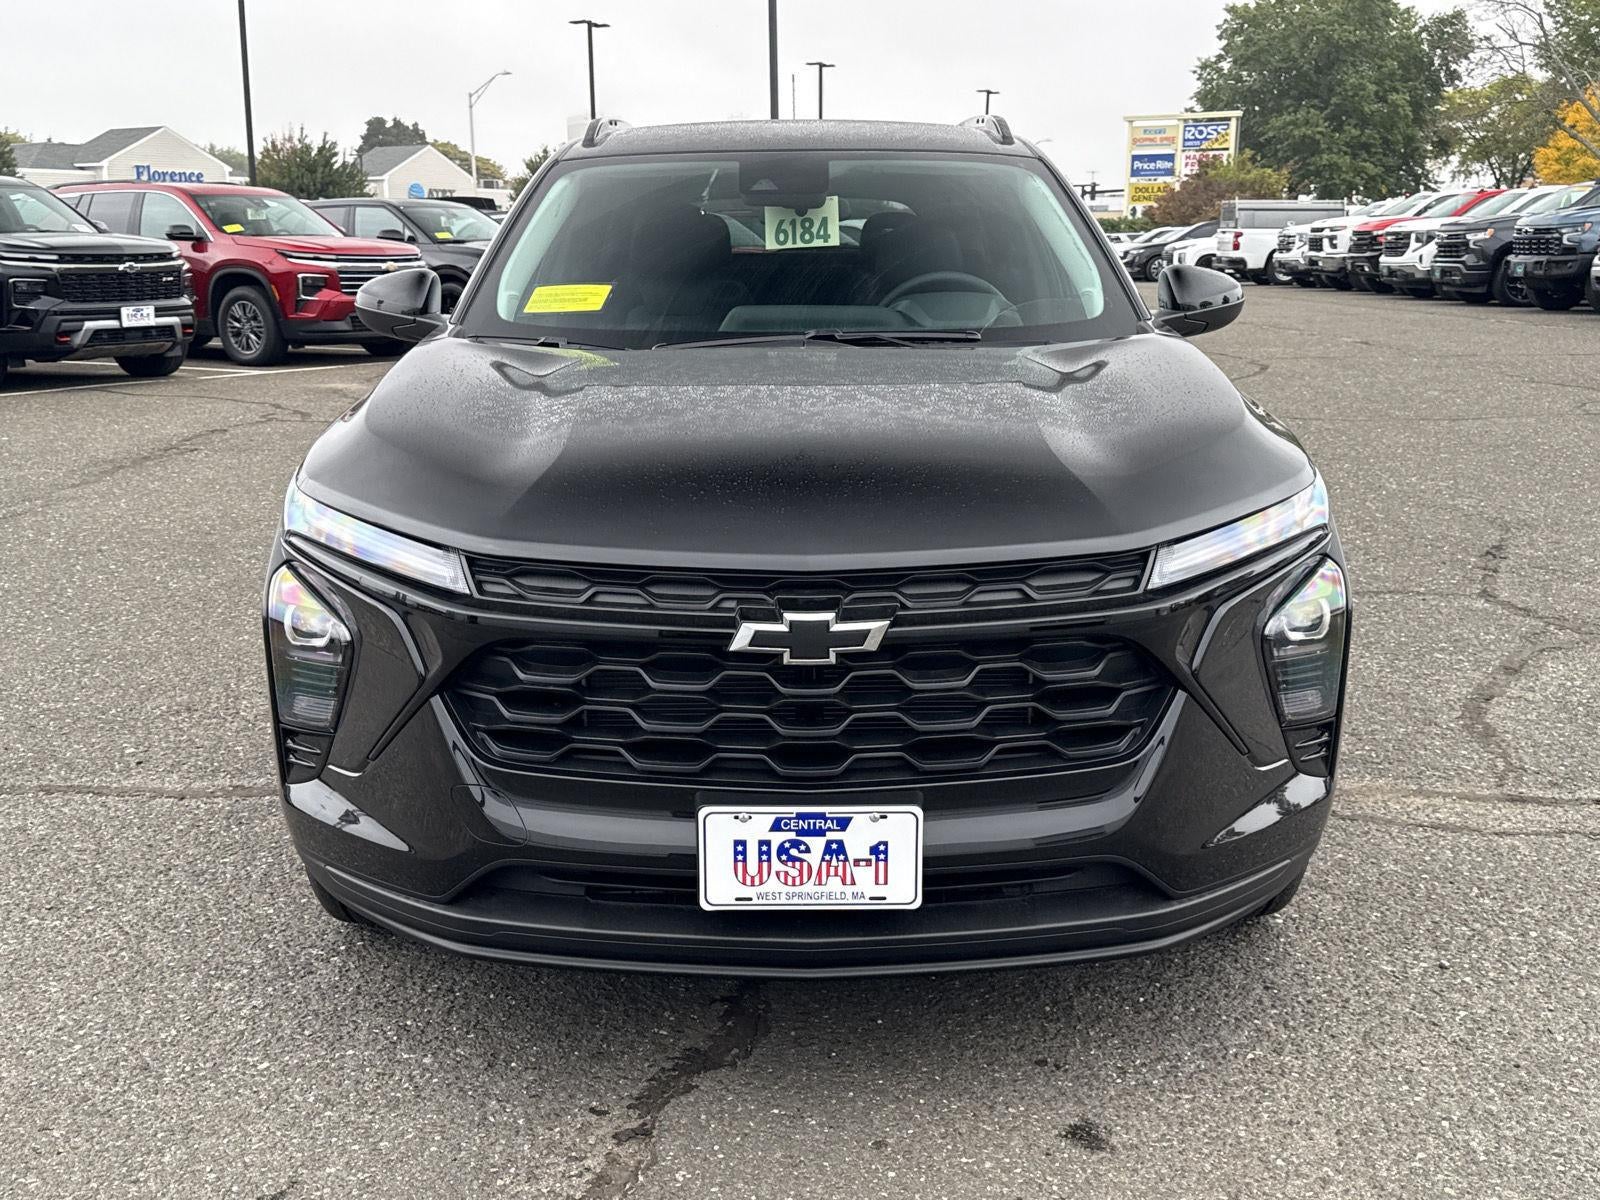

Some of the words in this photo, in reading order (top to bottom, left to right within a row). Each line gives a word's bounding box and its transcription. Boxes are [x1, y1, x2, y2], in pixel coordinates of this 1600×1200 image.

[1184, 125, 1228, 140] ROSS
[1133, 160, 1156, 170] Price
[1156, 159, 1174, 169] Rite
[134, 164, 204, 183] Florence
[774, 216, 831, 247] 6184
[780, 818, 841, 831] CENTRAL
[733, 838, 889, 887] USA-1
[755, 891, 784, 901] WEST
[785, 891, 849, 901] SPRINGFIELD,
[851, 891, 866, 901] MA
